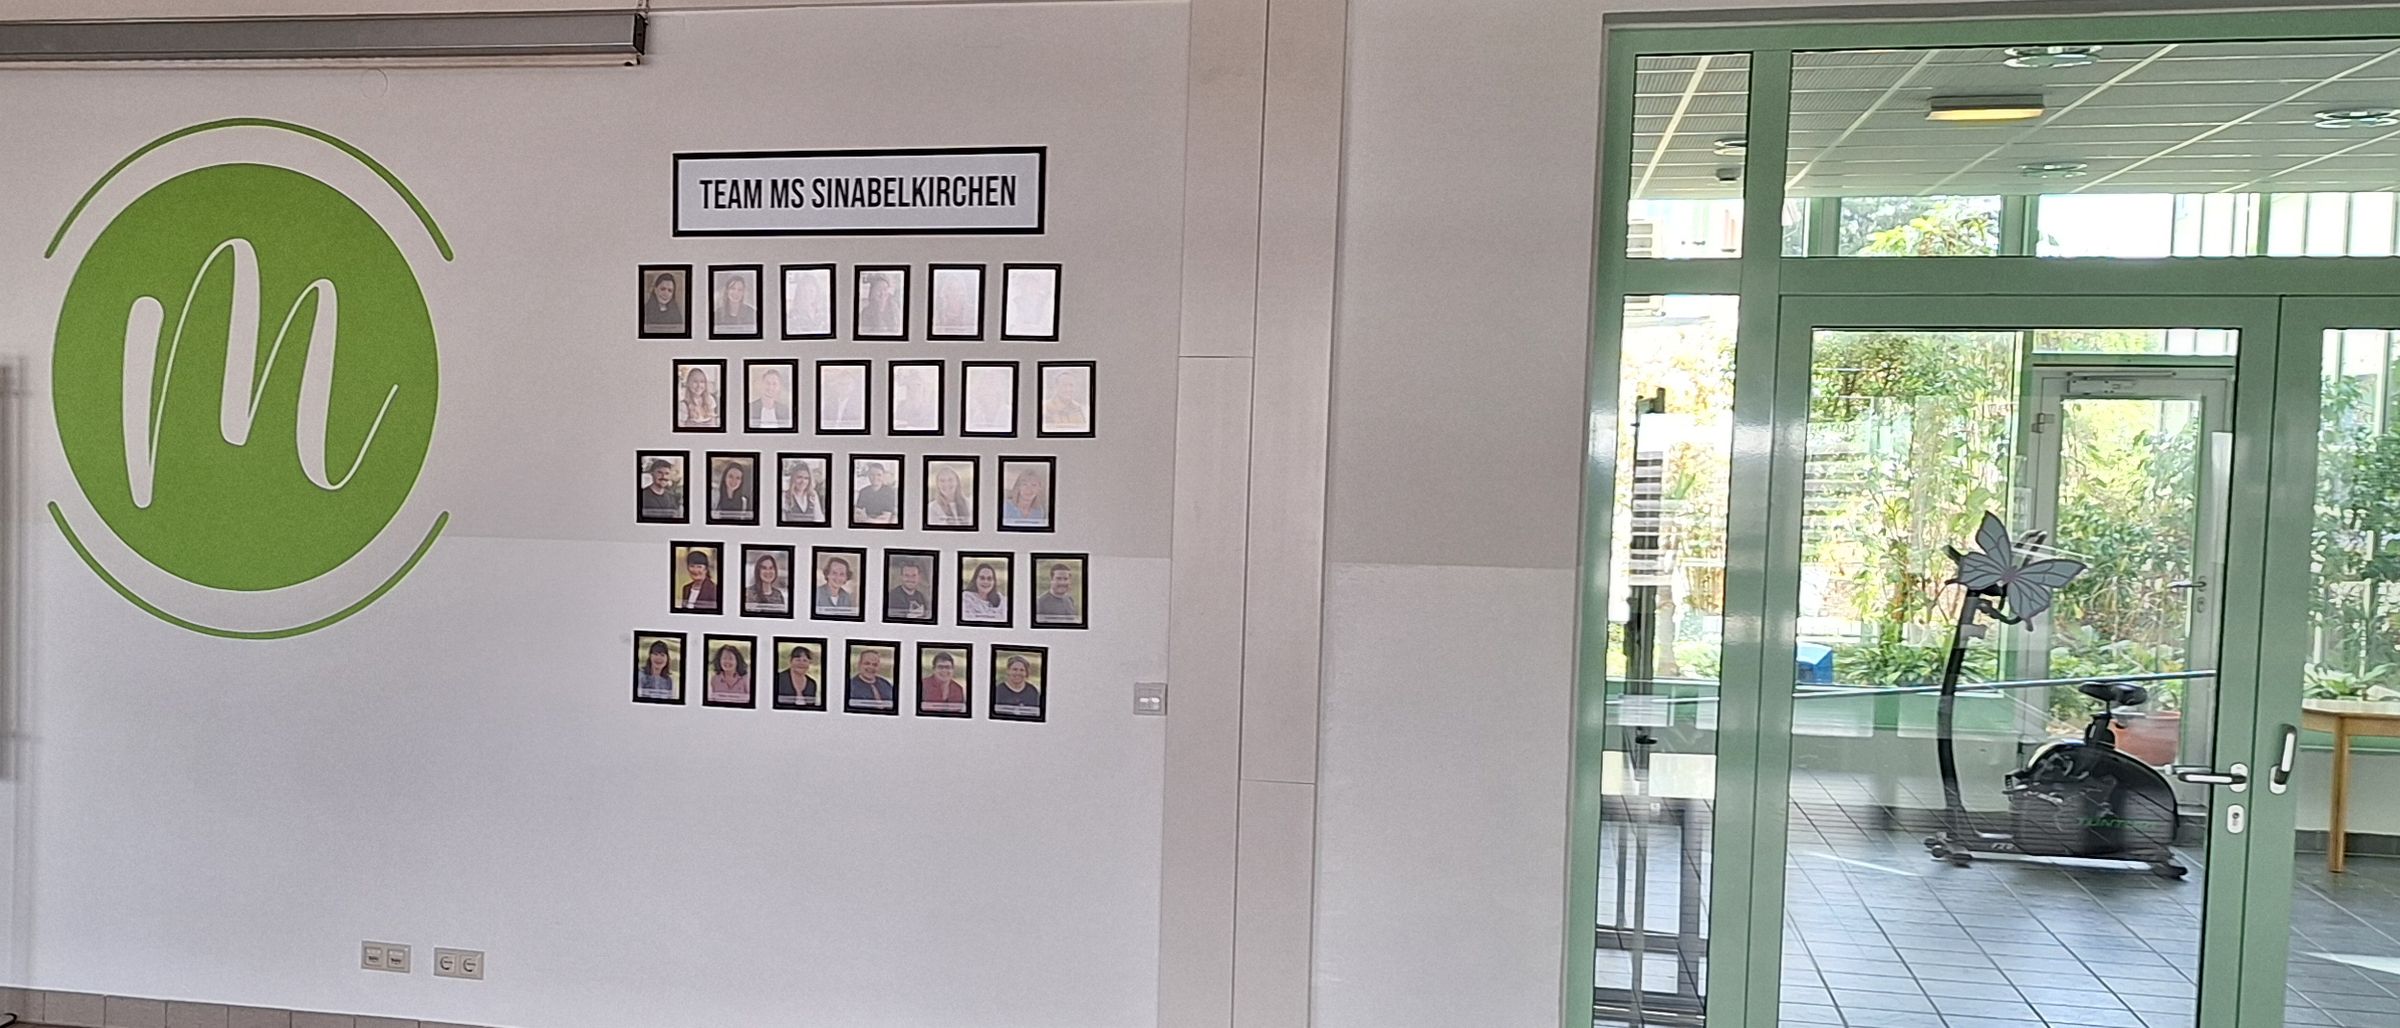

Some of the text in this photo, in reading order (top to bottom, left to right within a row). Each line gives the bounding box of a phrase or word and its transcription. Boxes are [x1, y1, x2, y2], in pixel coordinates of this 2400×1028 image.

[700, 175, 1016, 209] TEAM MS SINABELKIRCHEN
